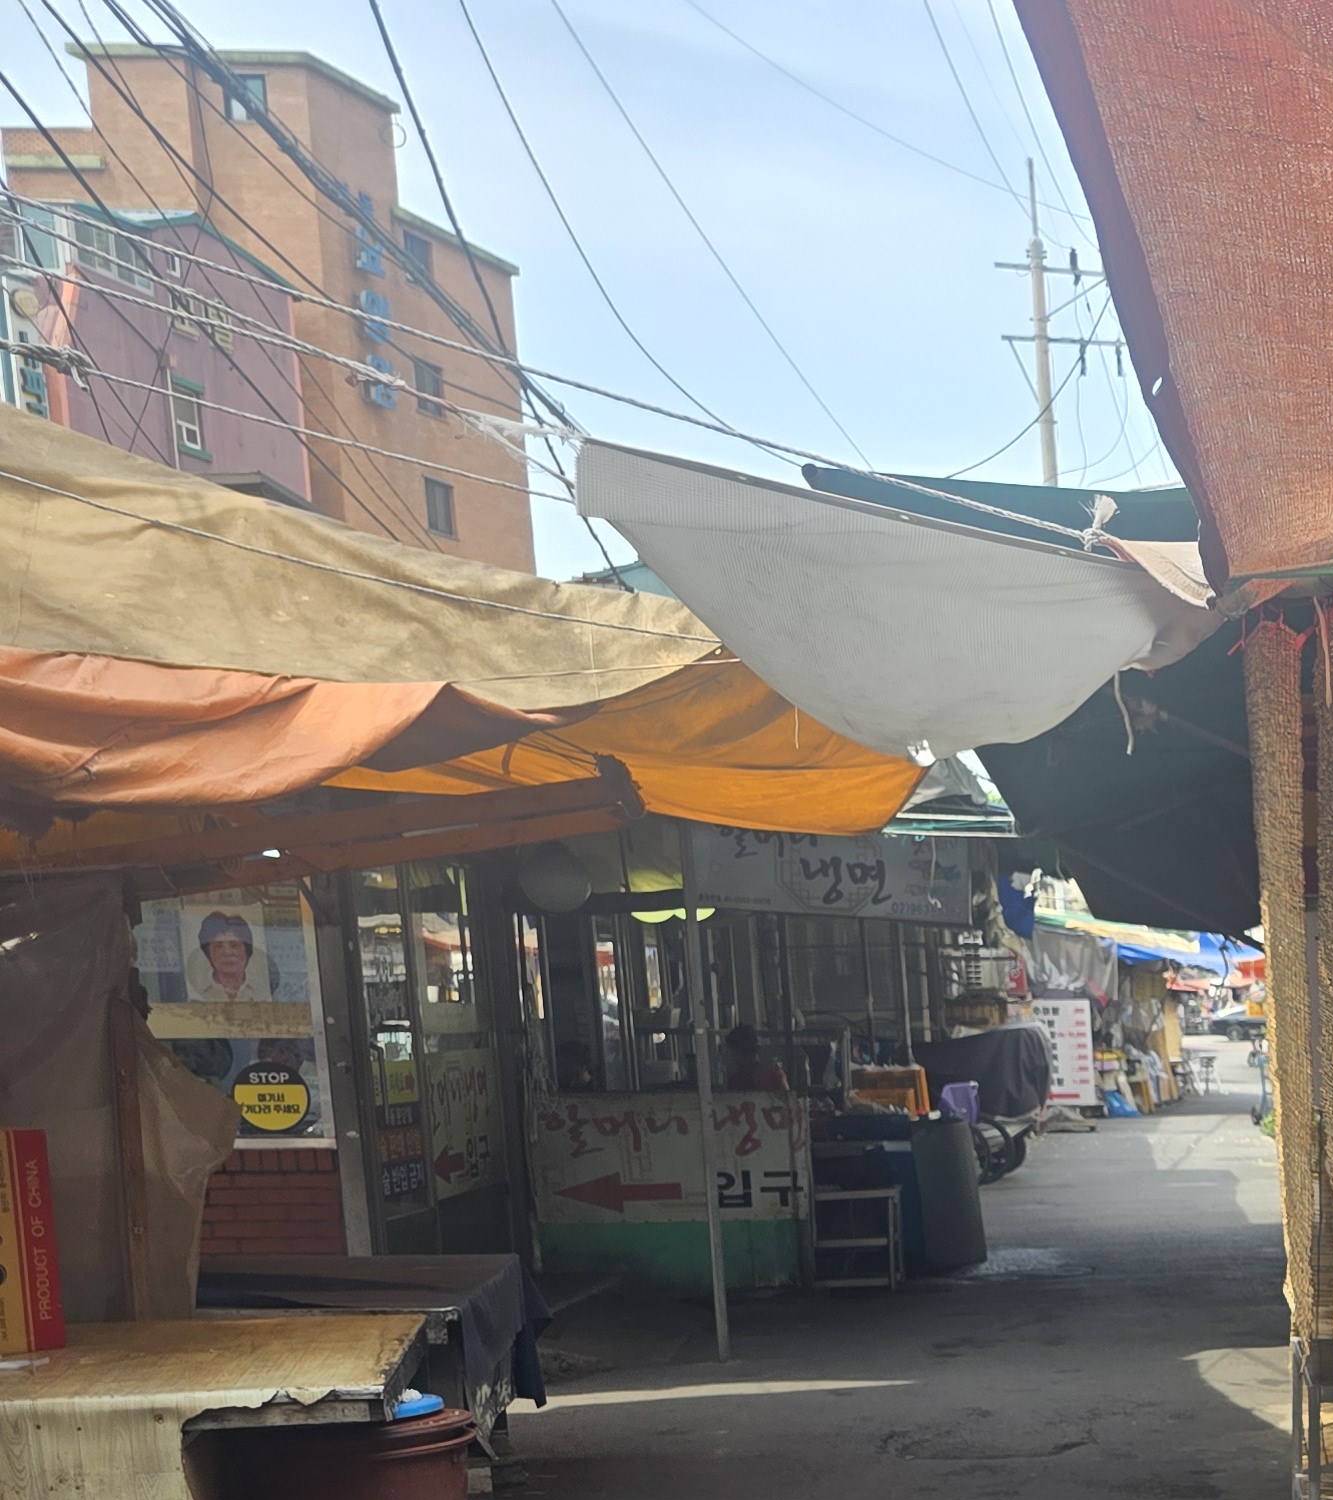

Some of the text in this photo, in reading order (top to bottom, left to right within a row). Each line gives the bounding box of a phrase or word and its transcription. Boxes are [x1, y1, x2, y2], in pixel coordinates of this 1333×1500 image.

[800, 856, 892, 905] 냉면
[248, 1072, 290, 1084] STOP
[716, 1170, 804, 1209] 입구
[25, 1159, 51, 1321] PRODUCT OF CHINA
